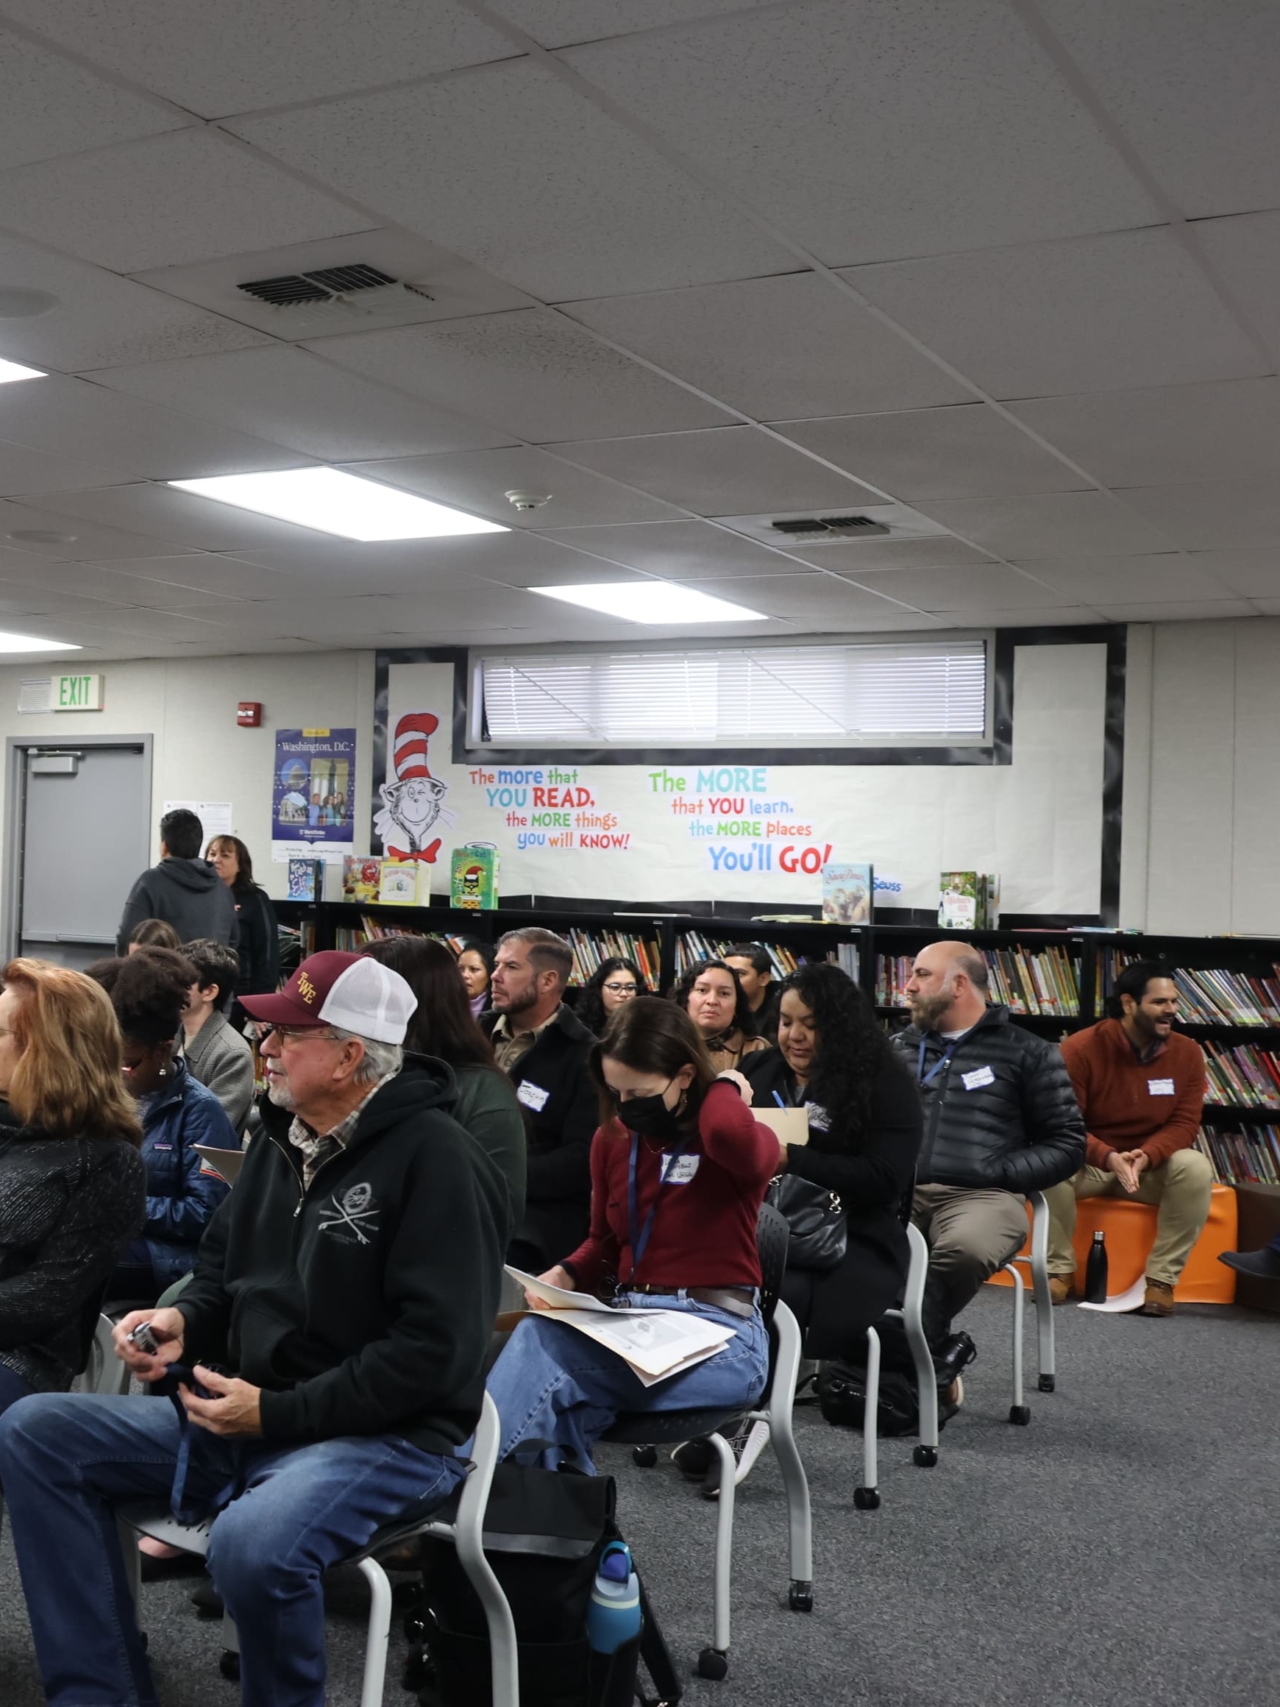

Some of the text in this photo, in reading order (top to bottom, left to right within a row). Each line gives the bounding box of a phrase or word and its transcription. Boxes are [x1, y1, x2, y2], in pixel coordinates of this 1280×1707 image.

[60, 676, 91, 705] EXIT
[282, 741, 332, 754] Washington,
[469, 767, 578, 785] The more that
[648, 767, 767, 793] The MORE
[486, 787, 595, 808] YOU READ,
[671, 796, 704, 814] that
[708, 797, 745, 815] YOU
[506, 811, 618, 831] the MORE things
[689, 819, 812, 838] the MORE places
[517, 832, 631, 850] you will KNOW!
[708, 842, 833, 874] You'll GO!
[873, 876, 902, 893] Seuss
